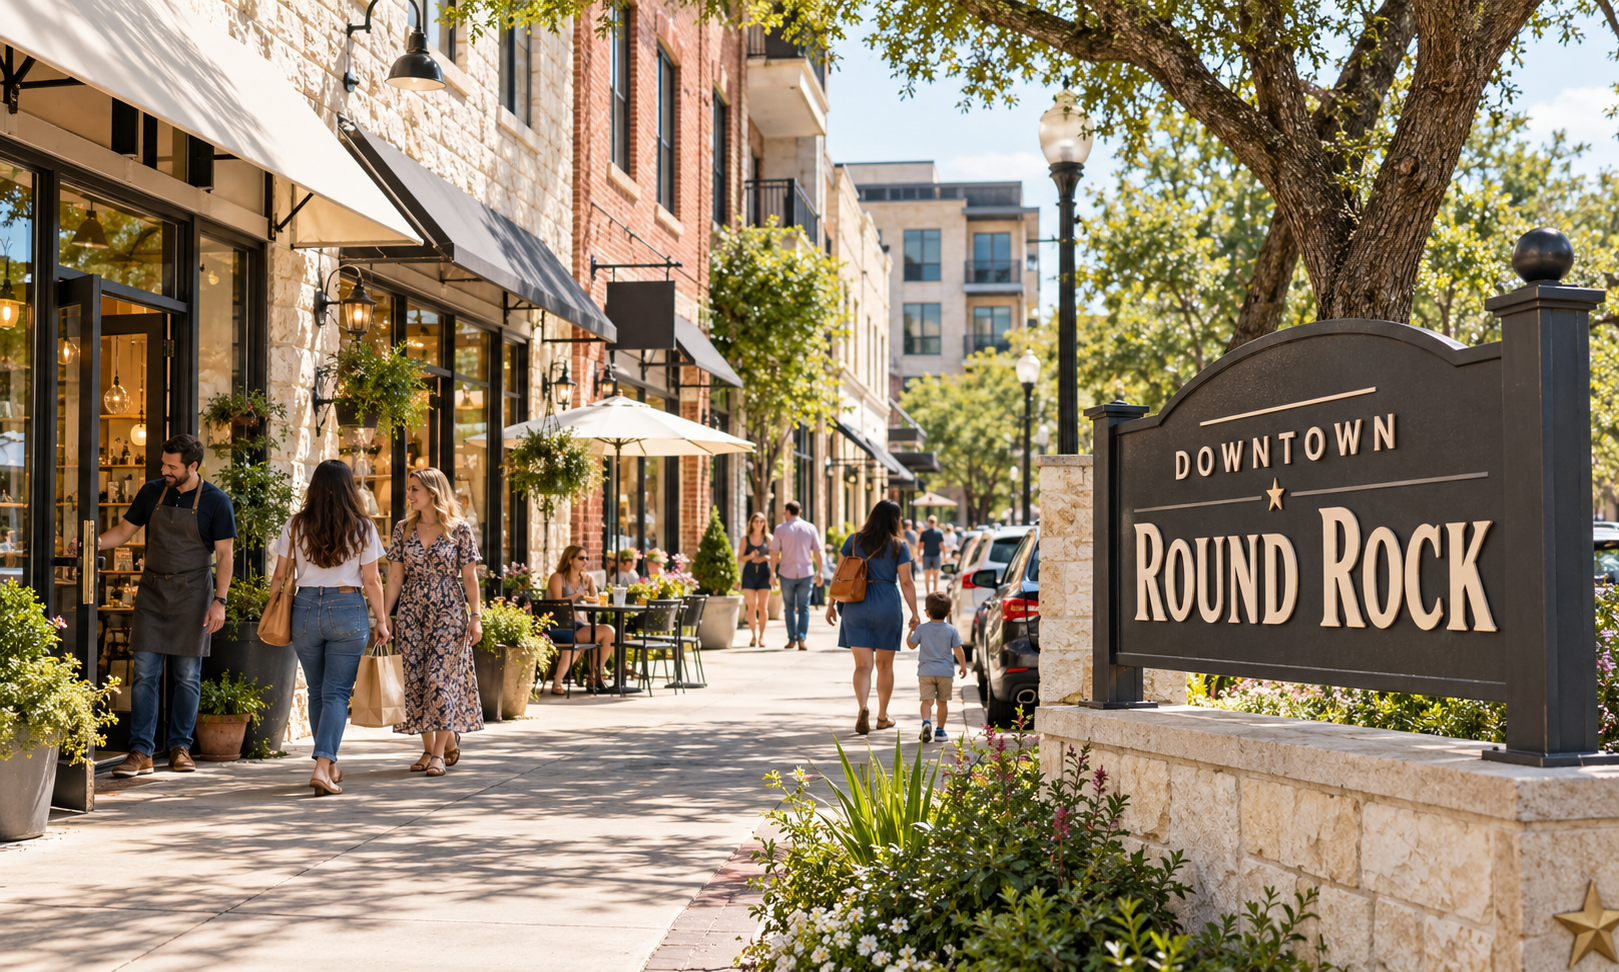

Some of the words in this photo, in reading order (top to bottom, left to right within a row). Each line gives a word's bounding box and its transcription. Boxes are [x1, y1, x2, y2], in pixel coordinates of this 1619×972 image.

[1175, 413, 1397, 481] DOWNTOWN
[1133, 522, 1299, 626] ROUND
[1318, 506, 1498, 632] ROCK
